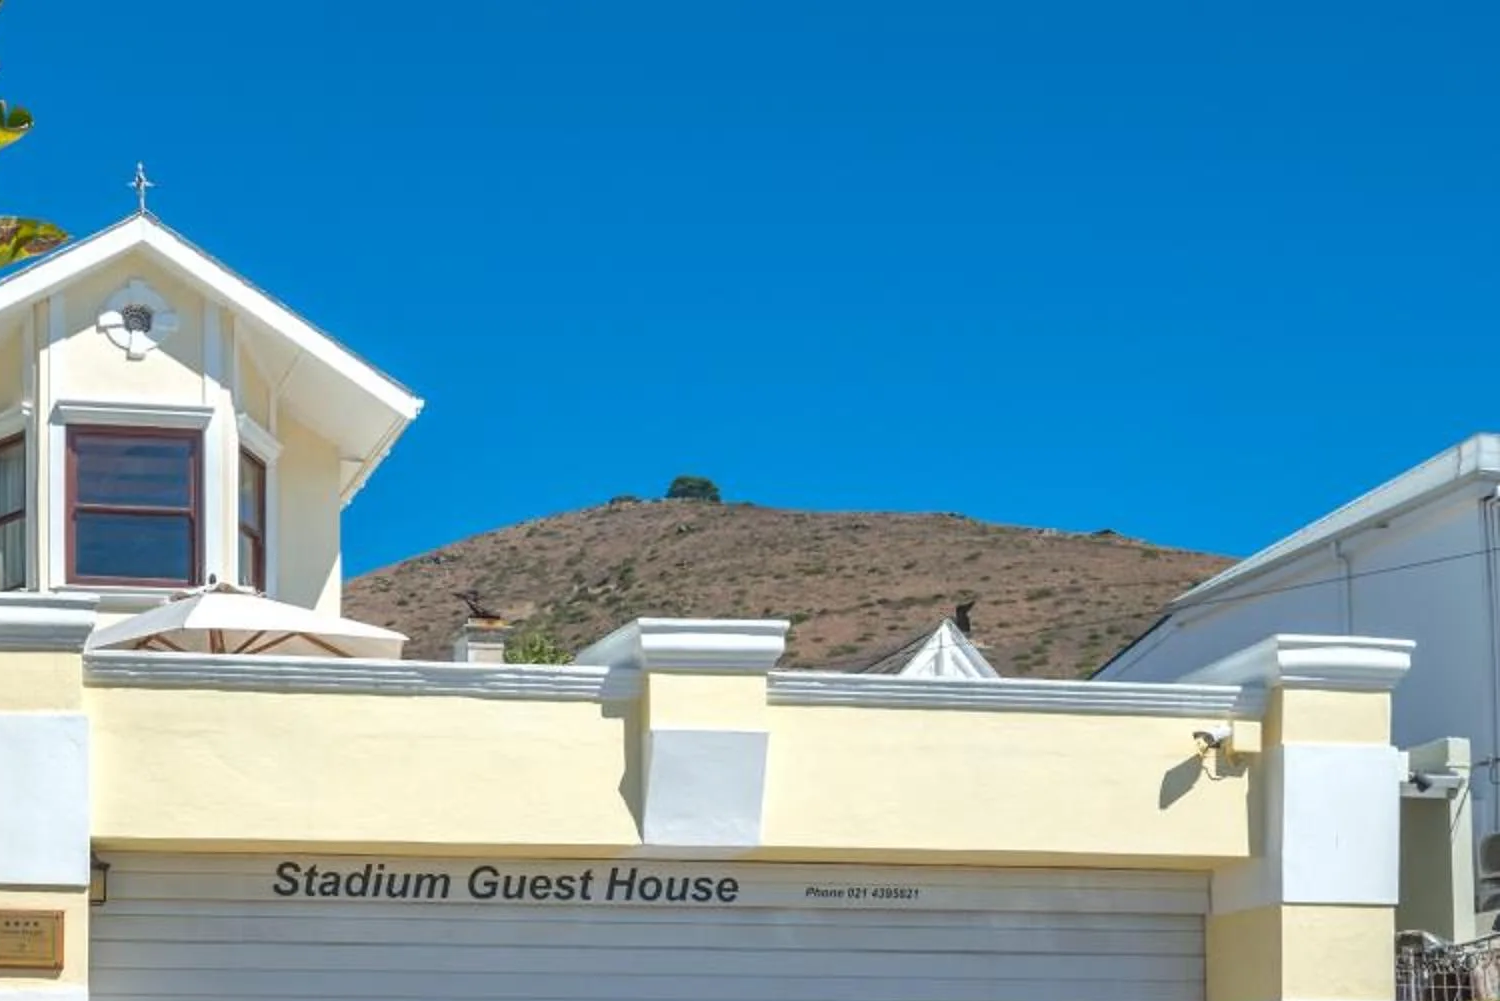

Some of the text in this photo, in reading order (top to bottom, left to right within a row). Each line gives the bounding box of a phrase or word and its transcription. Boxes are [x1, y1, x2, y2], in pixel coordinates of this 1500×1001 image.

[273, 861, 740, 902] Stadium Guest House
[805, 887, 845, 898] Phone
[847, 887, 867, 899] 021
